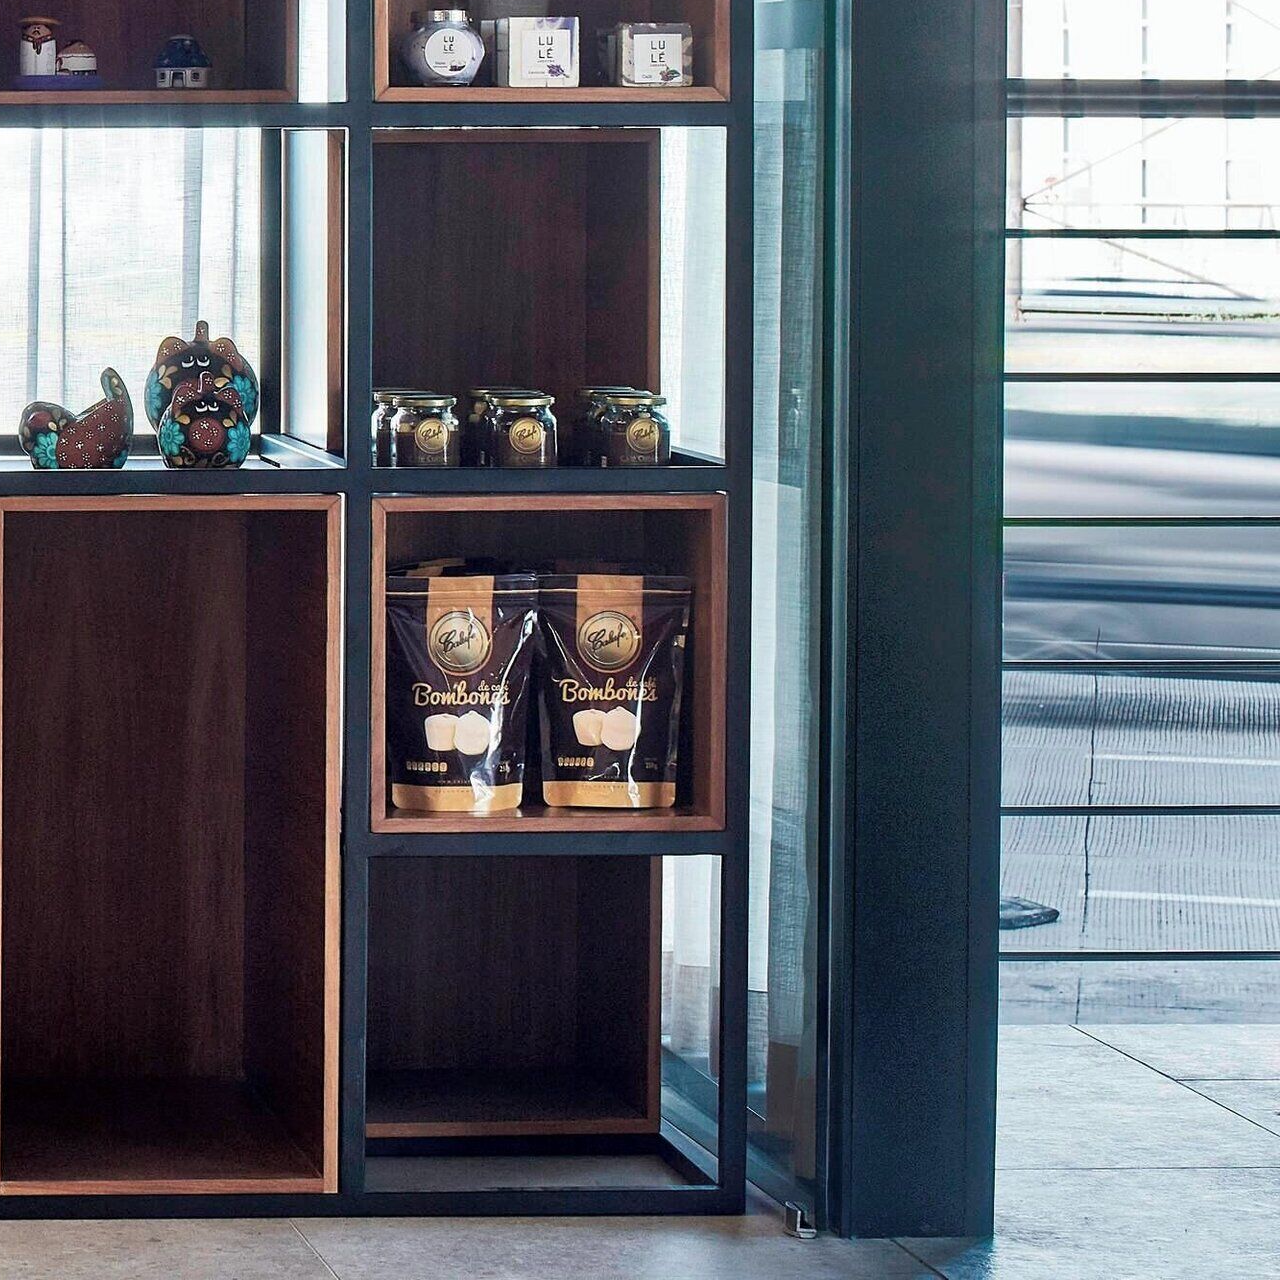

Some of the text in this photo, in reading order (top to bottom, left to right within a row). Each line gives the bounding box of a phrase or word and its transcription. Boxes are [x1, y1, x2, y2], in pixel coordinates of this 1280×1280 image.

[538, 36, 554, 45] LU
[650, 40, 666, 50] LU
[538, 47, 554, 59] LÉ
[650, 51, 666, 63] LÉ
[479, 680, 490, 692] de
[627, 676, 637, 688] de
[412, 681, 511, 706] Bombones
[559, 676, 658, 702] Bombones
